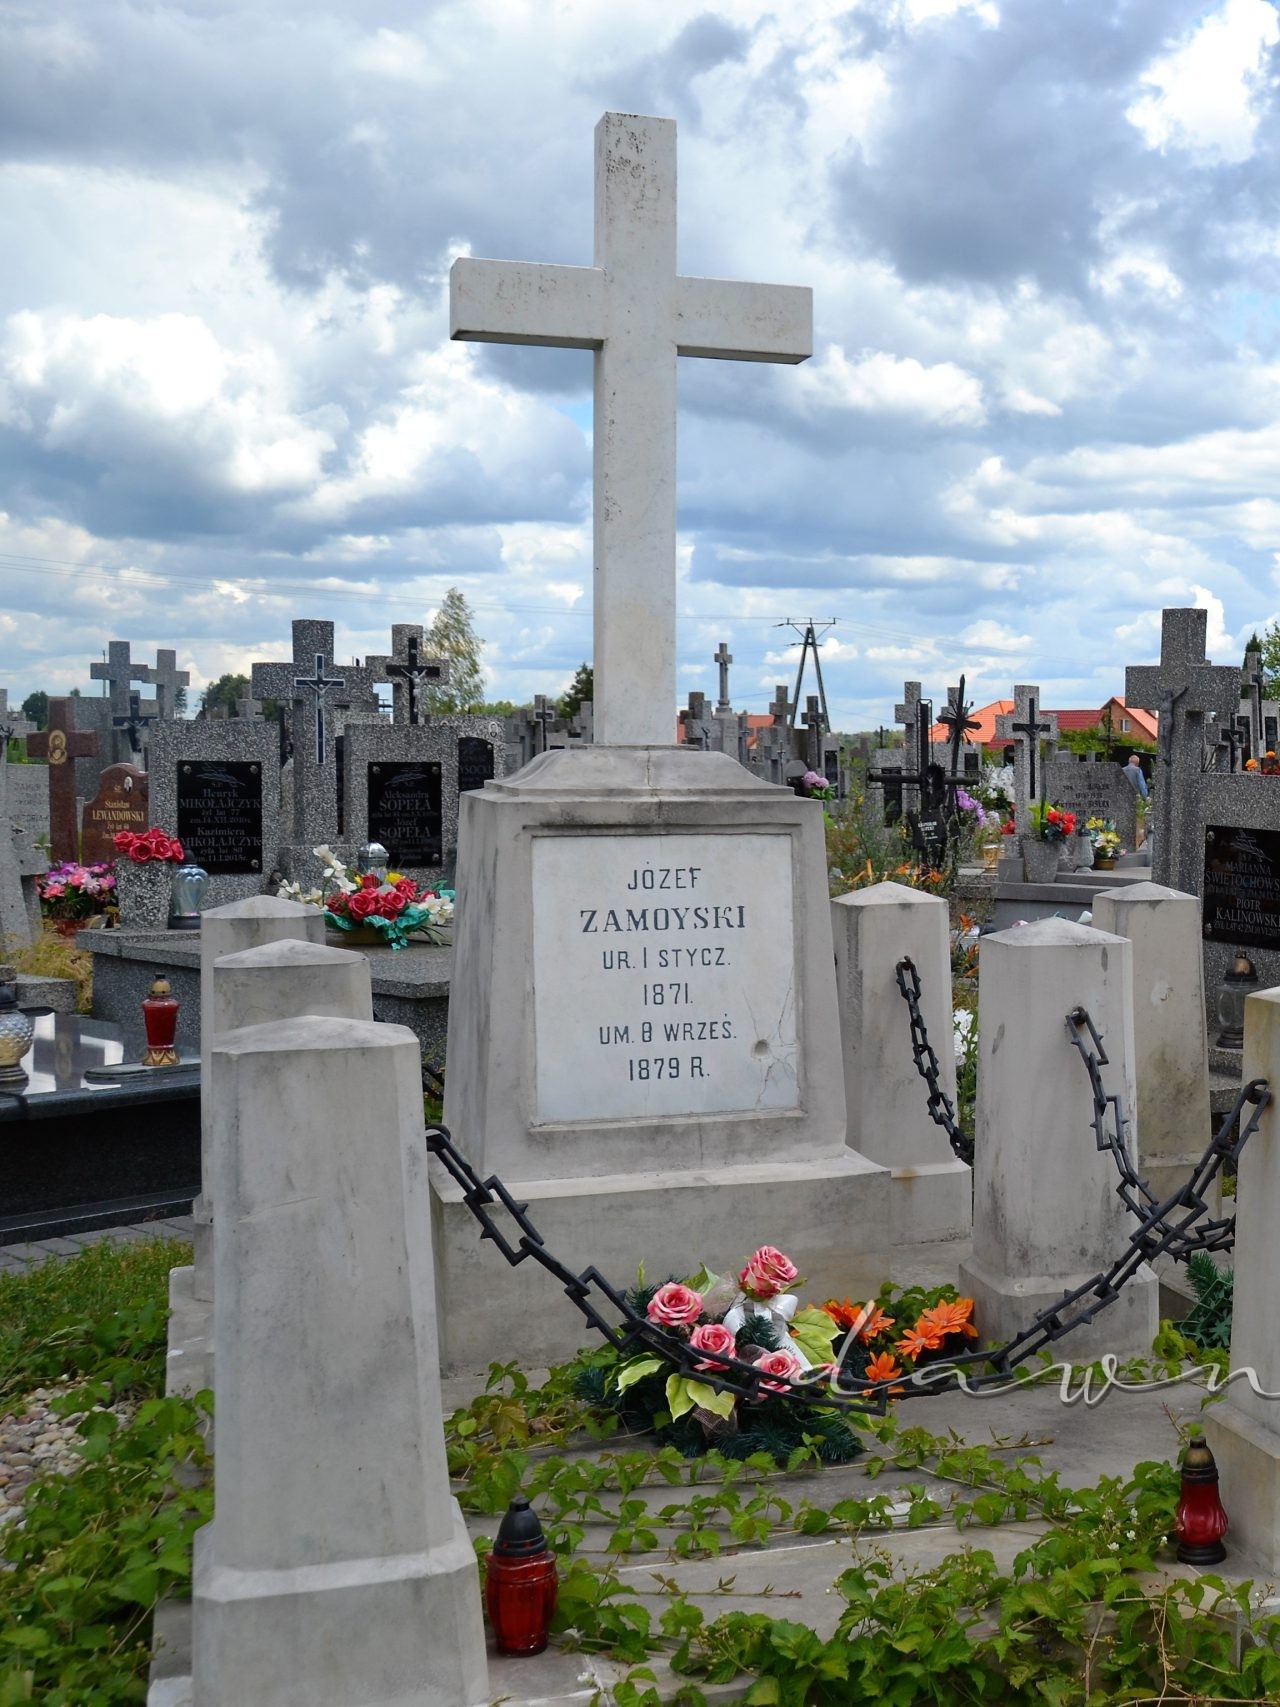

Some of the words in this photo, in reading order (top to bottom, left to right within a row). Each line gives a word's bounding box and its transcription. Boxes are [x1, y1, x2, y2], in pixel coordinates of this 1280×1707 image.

[203, 788, 239, 799] Henryk
[179, 798, 262, 809] MIKOŁAJCZYK
[92, 809, 144, 822] LEWANDOWSKI
[197, 827, 245, 836] Kazimiera
[1225, 861, 1271, 876] MARIANNA
[1236, 898, 1261, 911] PIOTR
[580, 905, 746, 934] ZAMOYSKI
[602, 951, 636, 970] UR.
[658, 948, 731, 968] STYCZ.
[643, 982, 694, 1006] 1871.
[599, 1025, 635, 1045] UM.
[641, 1021, 652, 1043] 8
[663, 1013, 737, 1041] WRZEŚ.
[629, 1058, 680, 1081] 1879
[691, 1056, 711, 1078] R.
